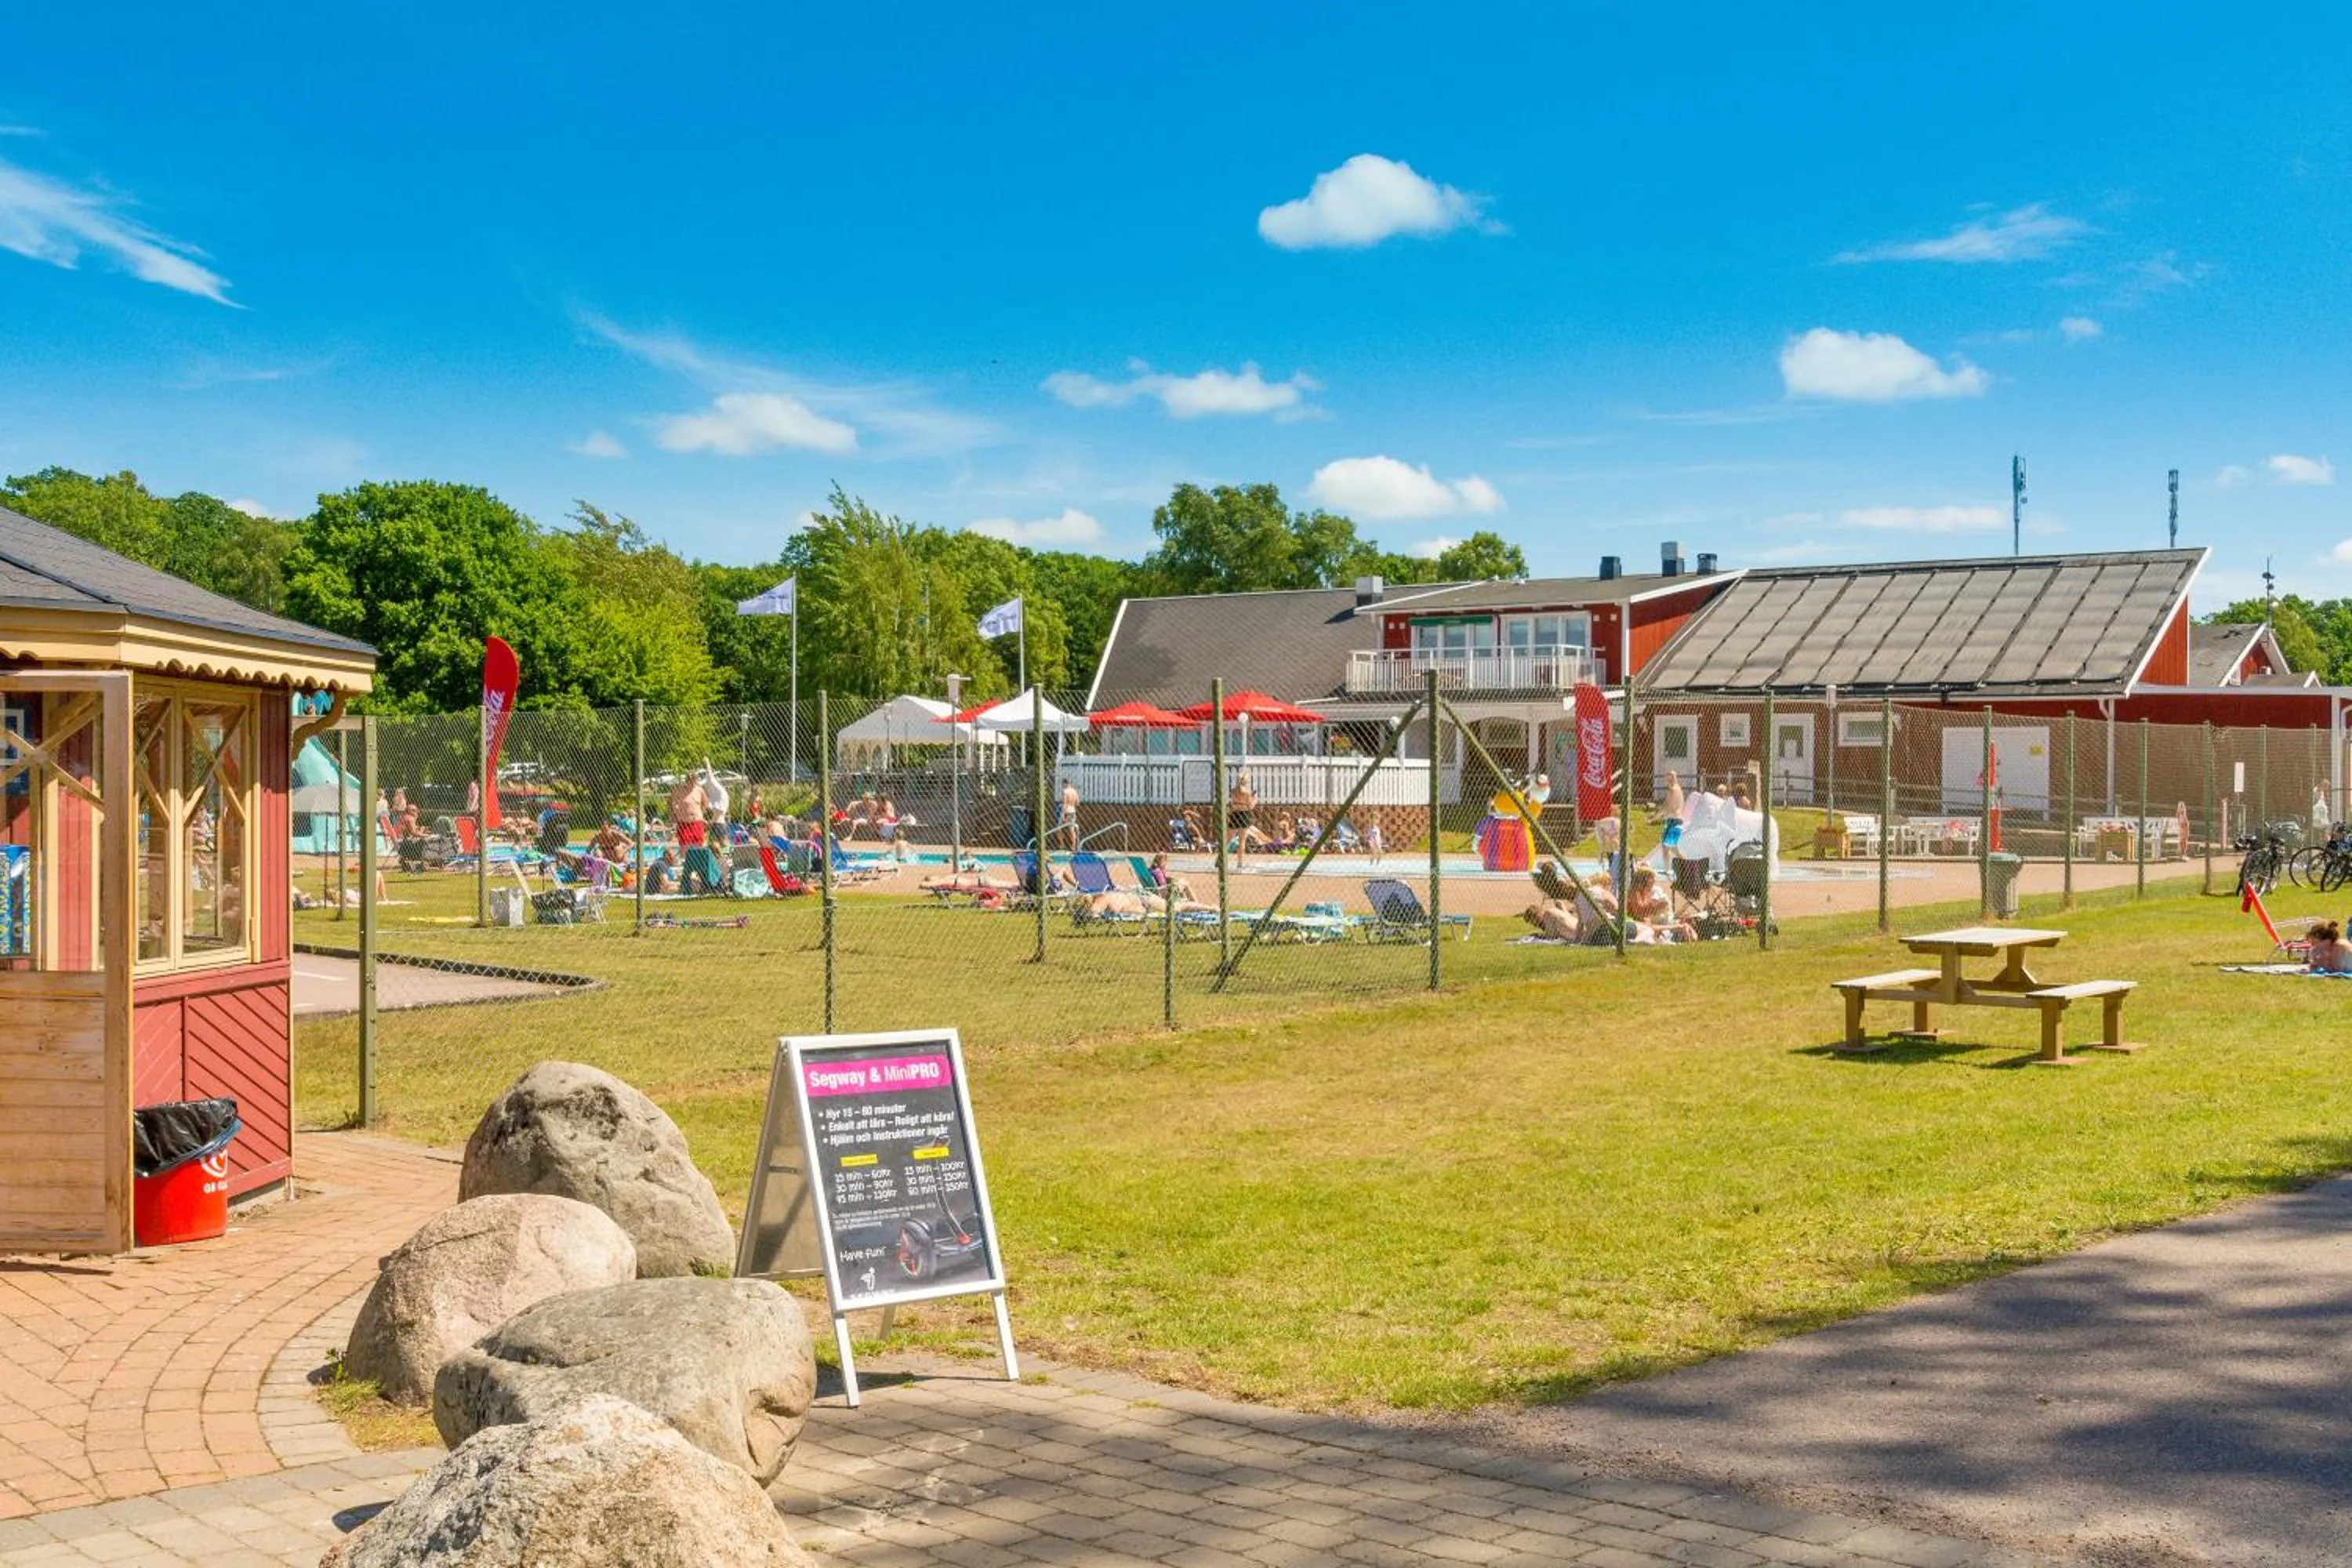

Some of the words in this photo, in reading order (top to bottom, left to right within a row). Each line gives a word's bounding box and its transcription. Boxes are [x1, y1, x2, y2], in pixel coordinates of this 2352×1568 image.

[1581, 717, 1607, 789] Coca-Cola
[809, 1069, 866, 1089] Segway
[869, 1066, 882, 1083] &
[884, 1062, 940, 1082] MiniPRO
[874, 1104, 906, 1116] minuter
[829, 1120, 855, 1132] Enkelt
[856, 1119, 868, 1130] att
[895, 1115, 919, 1127] Roligt
[920, 1113, 932, 1123] att
[830, 1134, 854, 1147] Hjälm
[856, 1132, 871, 1143] och
[840, 1250, 863, 1262] Have
